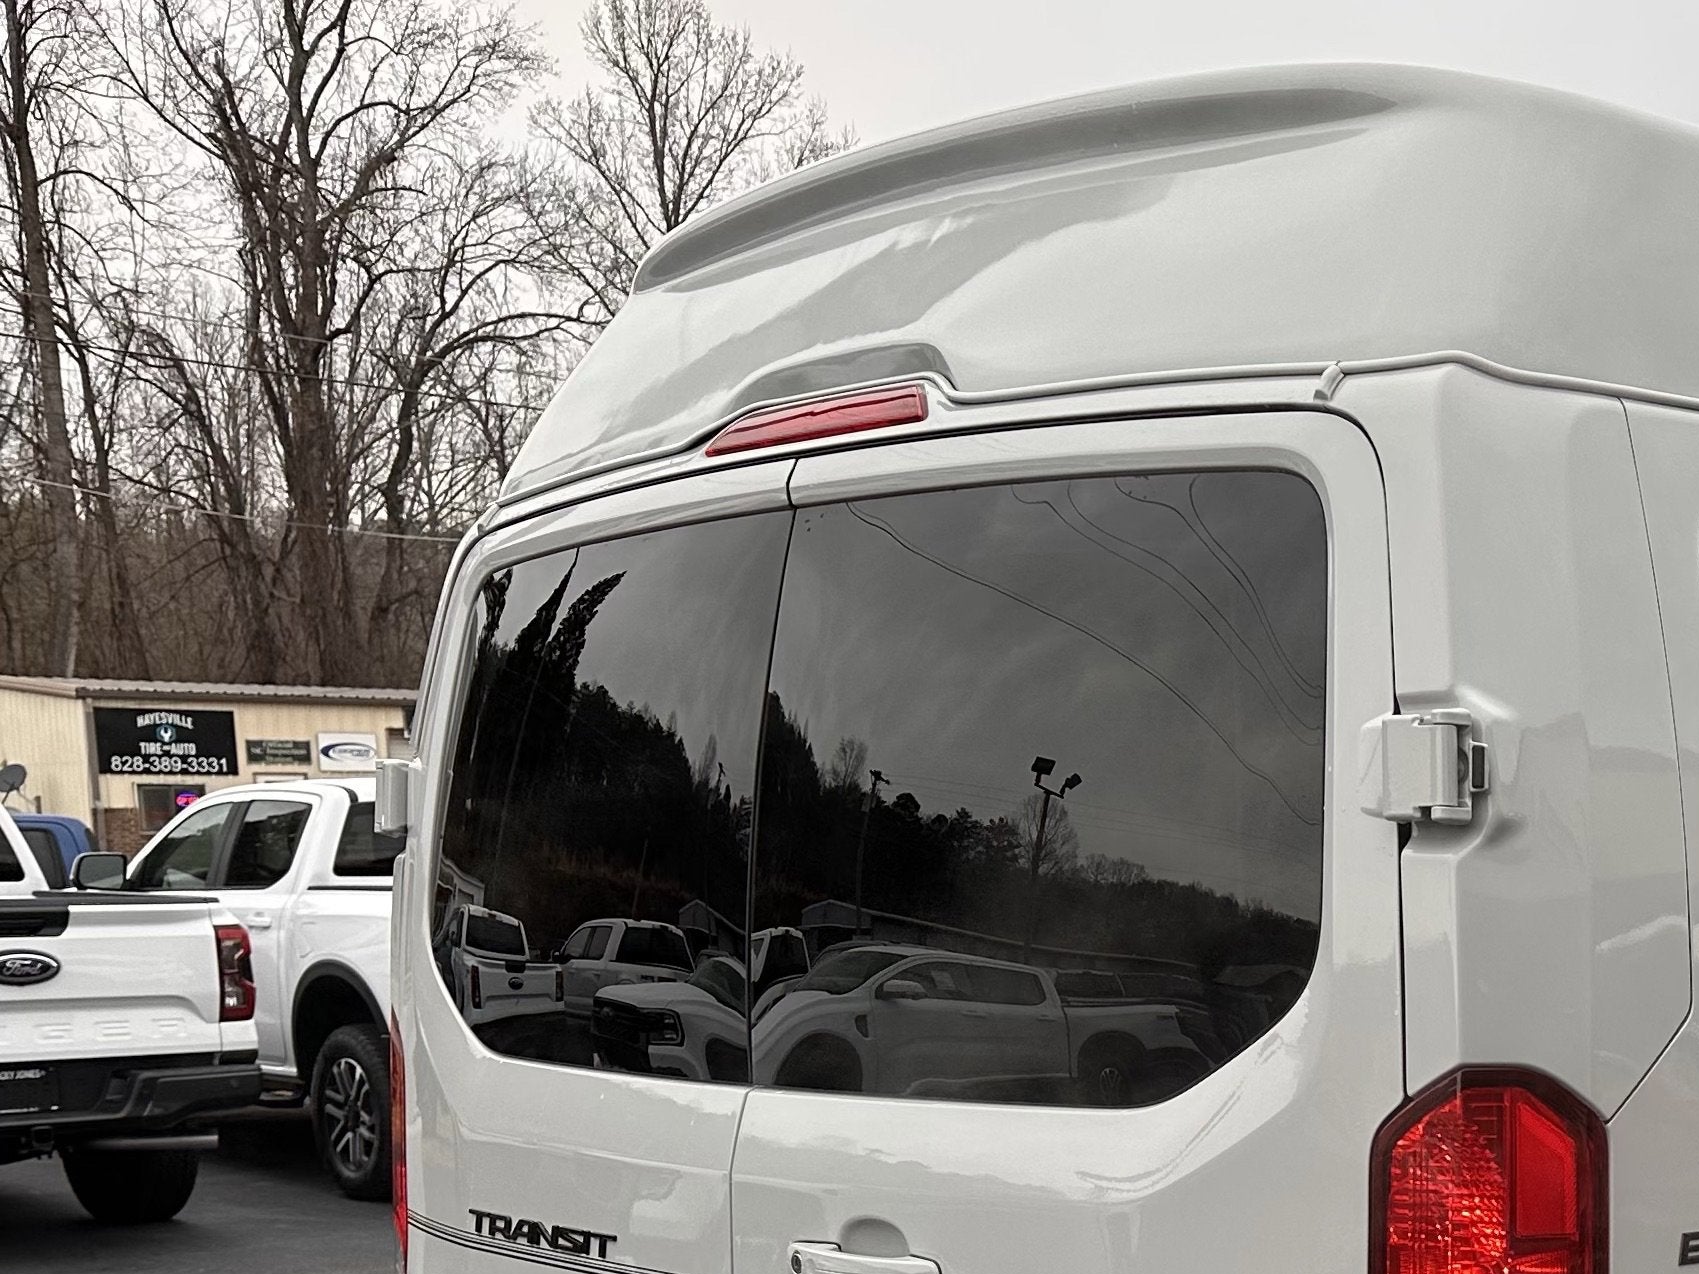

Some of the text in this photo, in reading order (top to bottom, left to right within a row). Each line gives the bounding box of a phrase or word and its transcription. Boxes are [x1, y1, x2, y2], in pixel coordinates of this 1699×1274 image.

[136, 712, 194, 729] HAYESVILLE
[139, 742, 163, 755] TIRE
[170, 743, 197, 755] AUTO
[110, 755, 228, 773] 828-389-3331
[468, 1208, 617, 1259] TRANSIT
